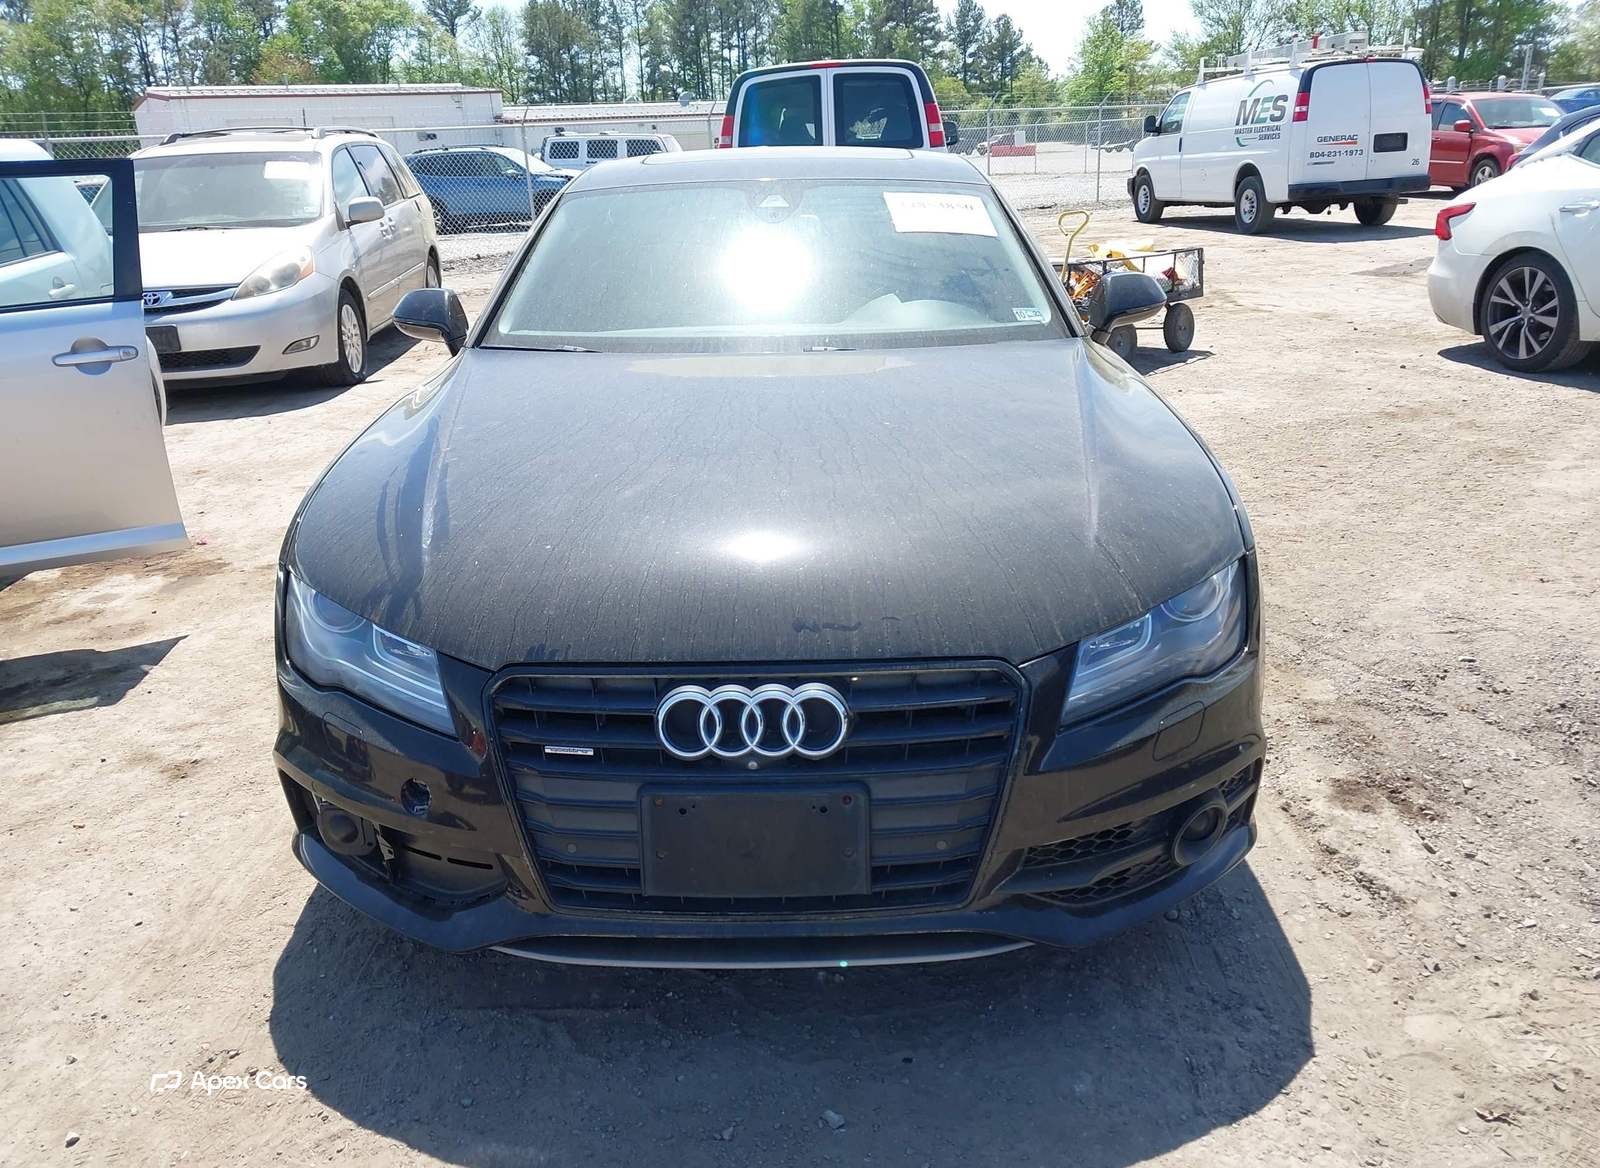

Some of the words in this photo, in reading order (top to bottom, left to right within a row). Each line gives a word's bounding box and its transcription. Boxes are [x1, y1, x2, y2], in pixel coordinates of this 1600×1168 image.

[1235, 94, 1289, 126] MES
[1234, 127, 1253, 135] MASTER
[1254, 125, 1281, 133] ELECTRICAL
[1258, 132, 1281, 141] SERVICES
[1317, 134, 1358, 143] GENERAC
[1309, 149, 1364, 159] 804-231-1973
[1411, 158, 1420, 166] 26
